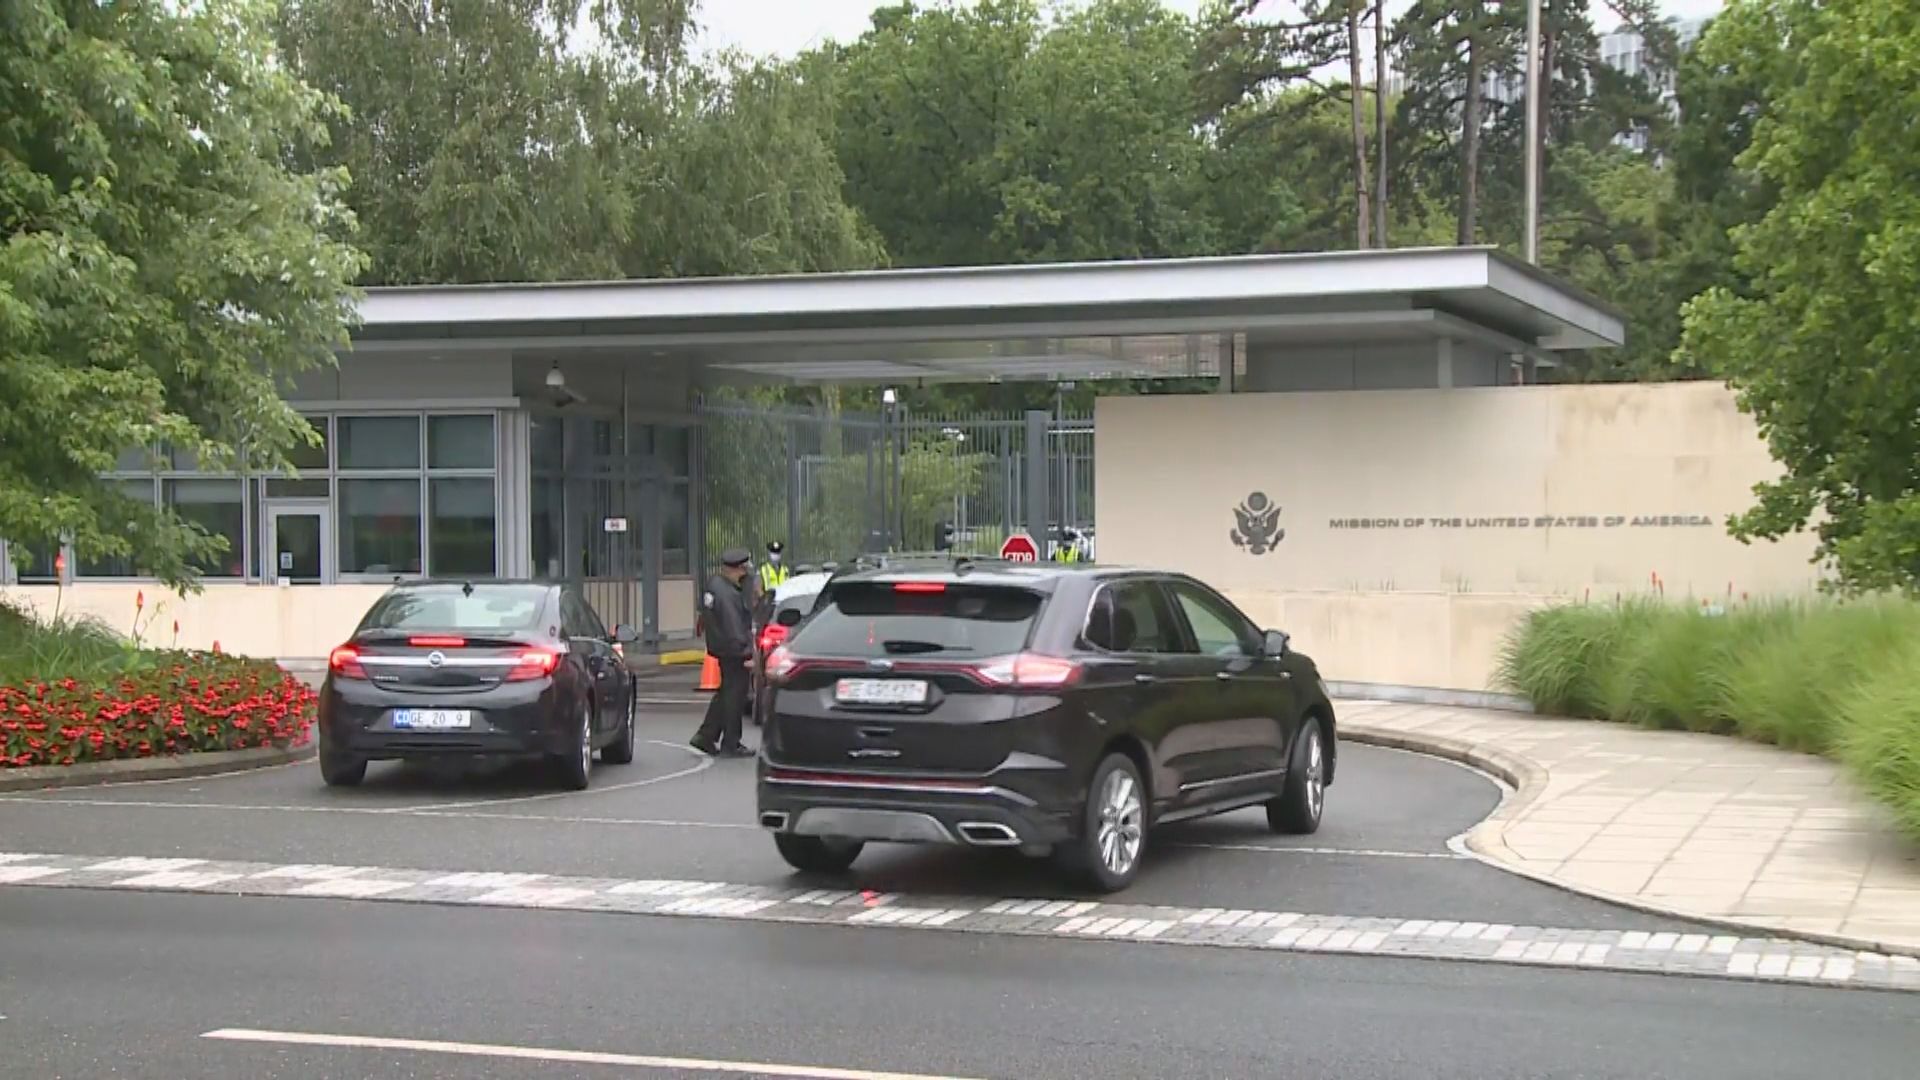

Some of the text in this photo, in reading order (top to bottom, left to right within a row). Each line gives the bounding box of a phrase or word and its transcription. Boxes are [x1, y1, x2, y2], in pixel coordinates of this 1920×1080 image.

[1329, 516, 1713, 529] MISSION OF THE UNITED STATES OF AMERICA
